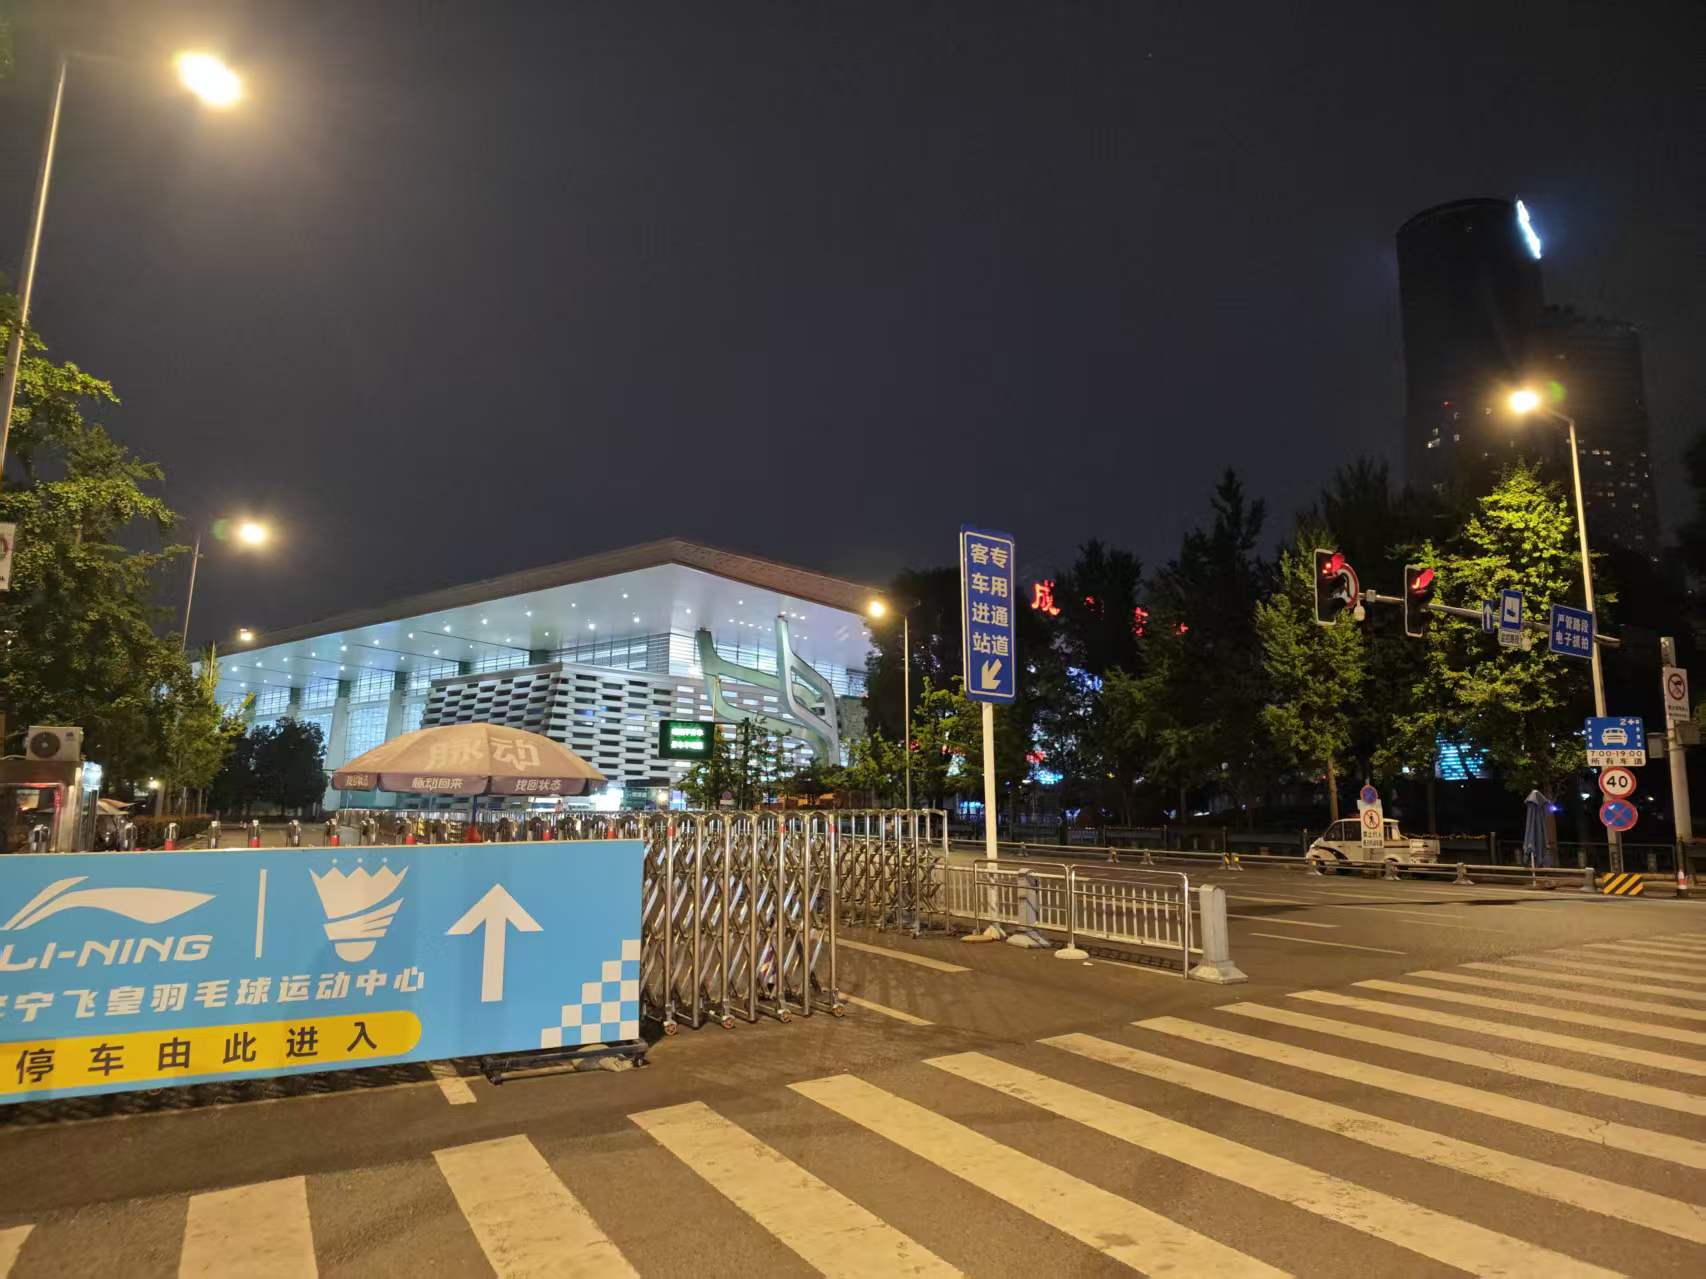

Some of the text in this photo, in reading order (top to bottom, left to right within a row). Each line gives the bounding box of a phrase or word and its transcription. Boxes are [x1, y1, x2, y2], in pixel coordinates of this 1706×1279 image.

[970, 543, 990, 655] 客车进站
[989, 547, 1009, 656] 专用通道
[424, 738, 540, 771] 脉动
[515, 779, 561, 792] 找回状态
[1606, 775, 1629, 788] 40
[0, 935, 214, 972] LI-NING
[0, 966, 425, 1023] 宁飞皇羽毛球运动中心
[16, 1021, 378, 1085] 停车由此进入
